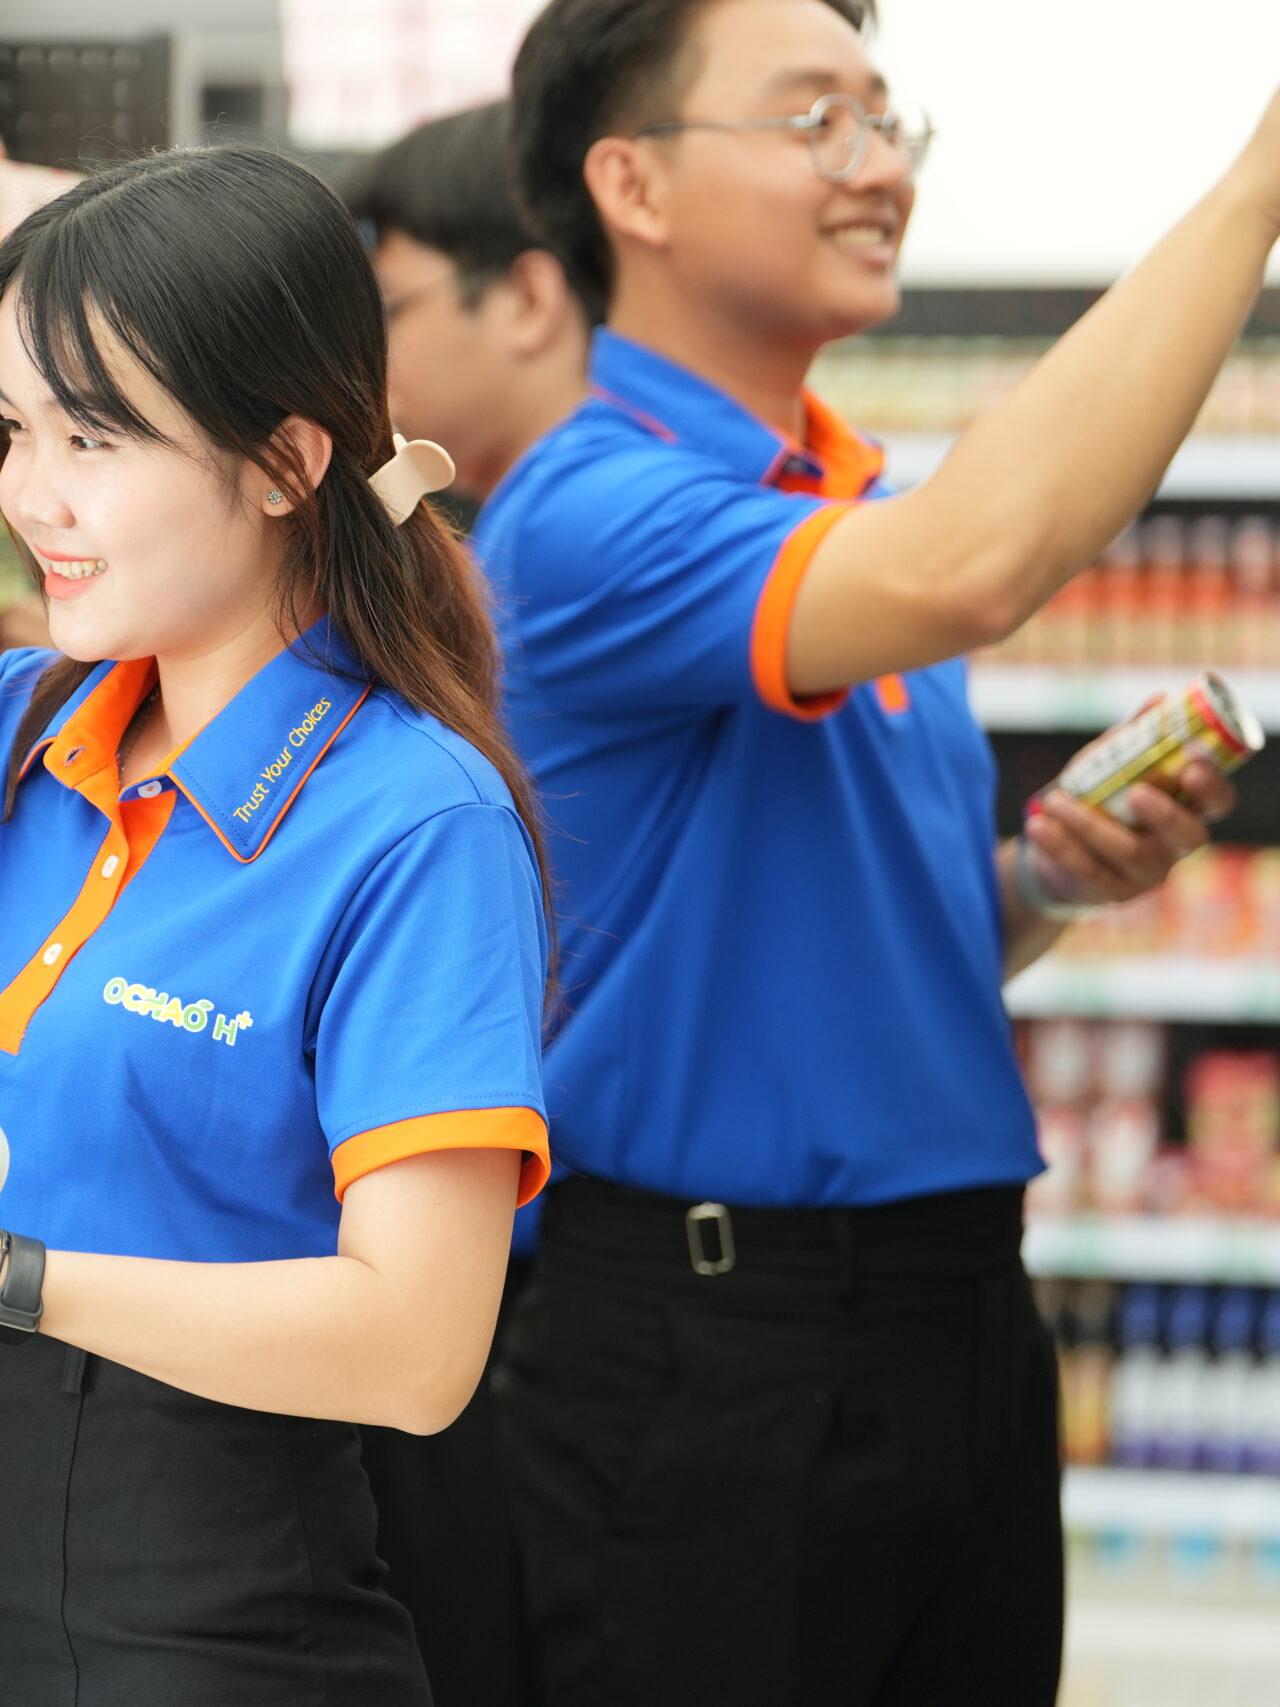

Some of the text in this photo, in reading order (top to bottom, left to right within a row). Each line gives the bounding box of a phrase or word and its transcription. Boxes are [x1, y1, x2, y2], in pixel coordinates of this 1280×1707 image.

[233, 697, 331, 823] Trust Your Choices
